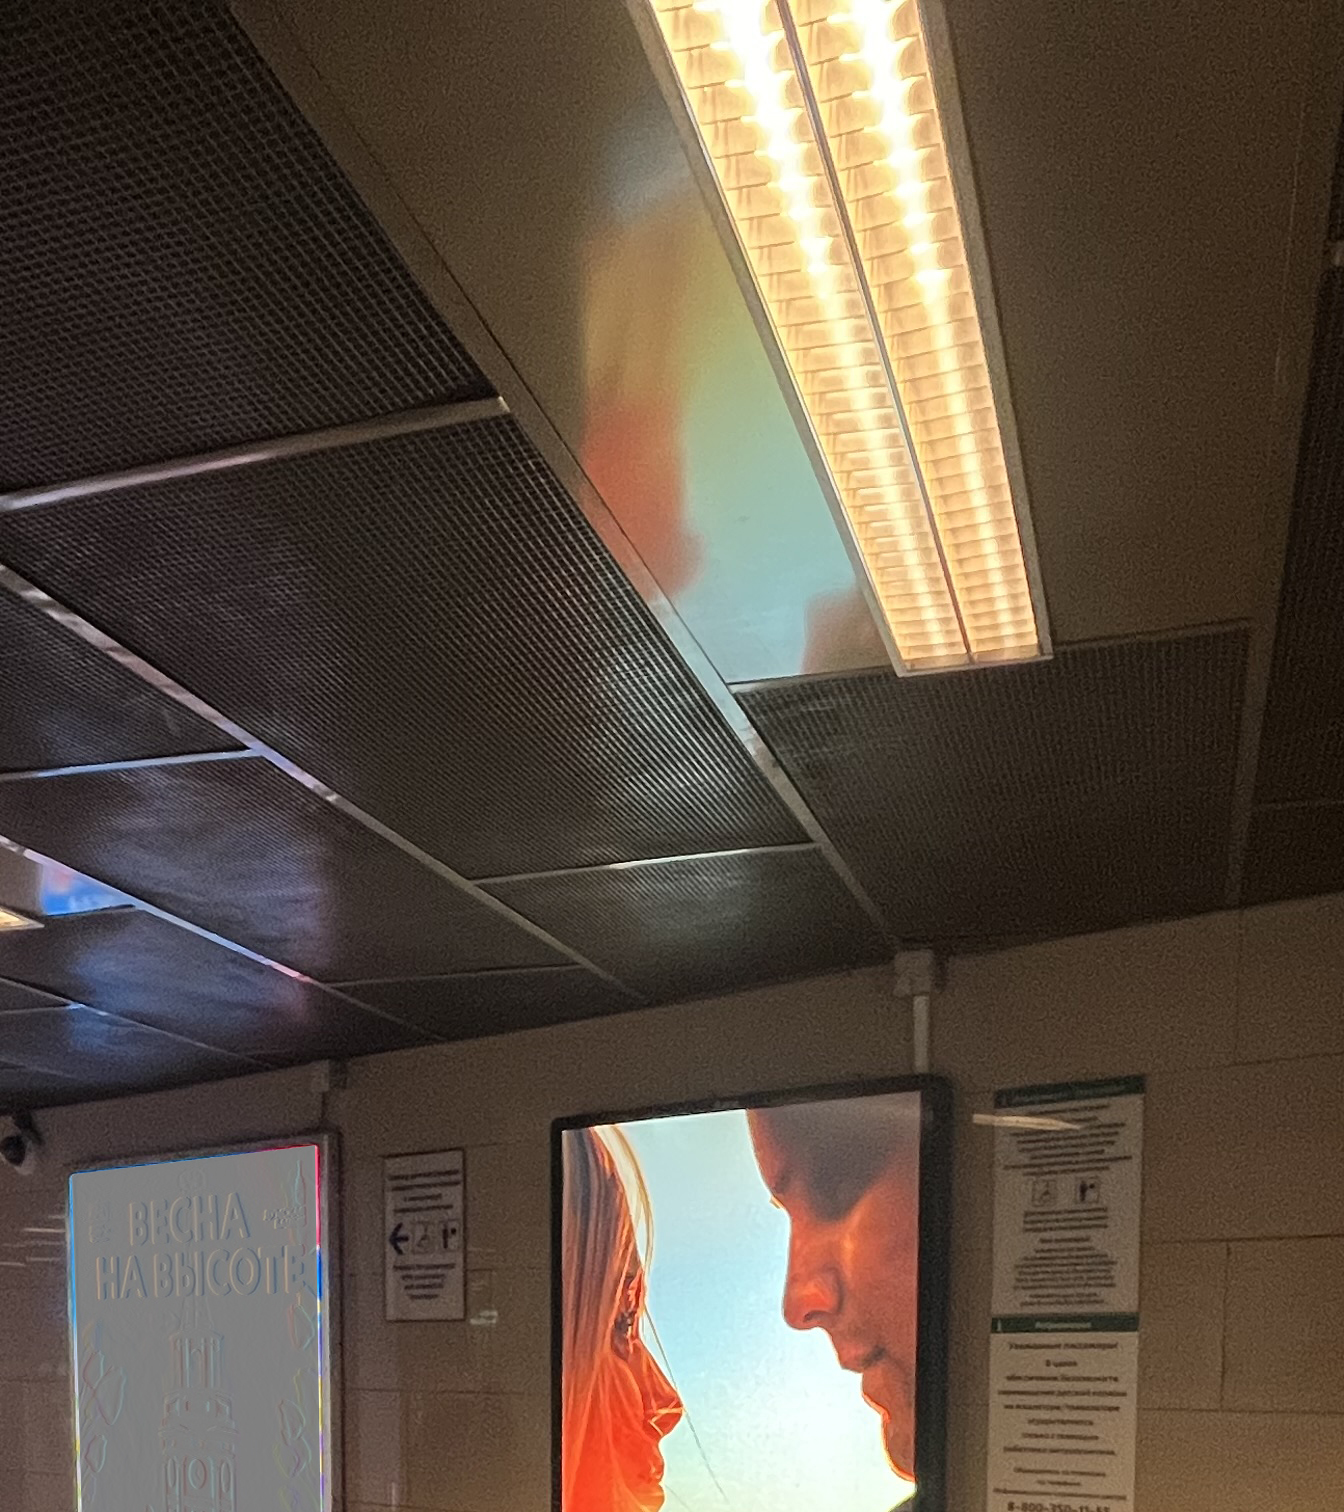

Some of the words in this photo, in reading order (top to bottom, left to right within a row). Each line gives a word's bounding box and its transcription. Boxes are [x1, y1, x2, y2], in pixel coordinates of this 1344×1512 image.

[129, 1192, 251, 1246] ВЕСНА
[95, 1255, 147, 1301] НА
[153, 1244, 306, 1299] ВЫСОТЕ
